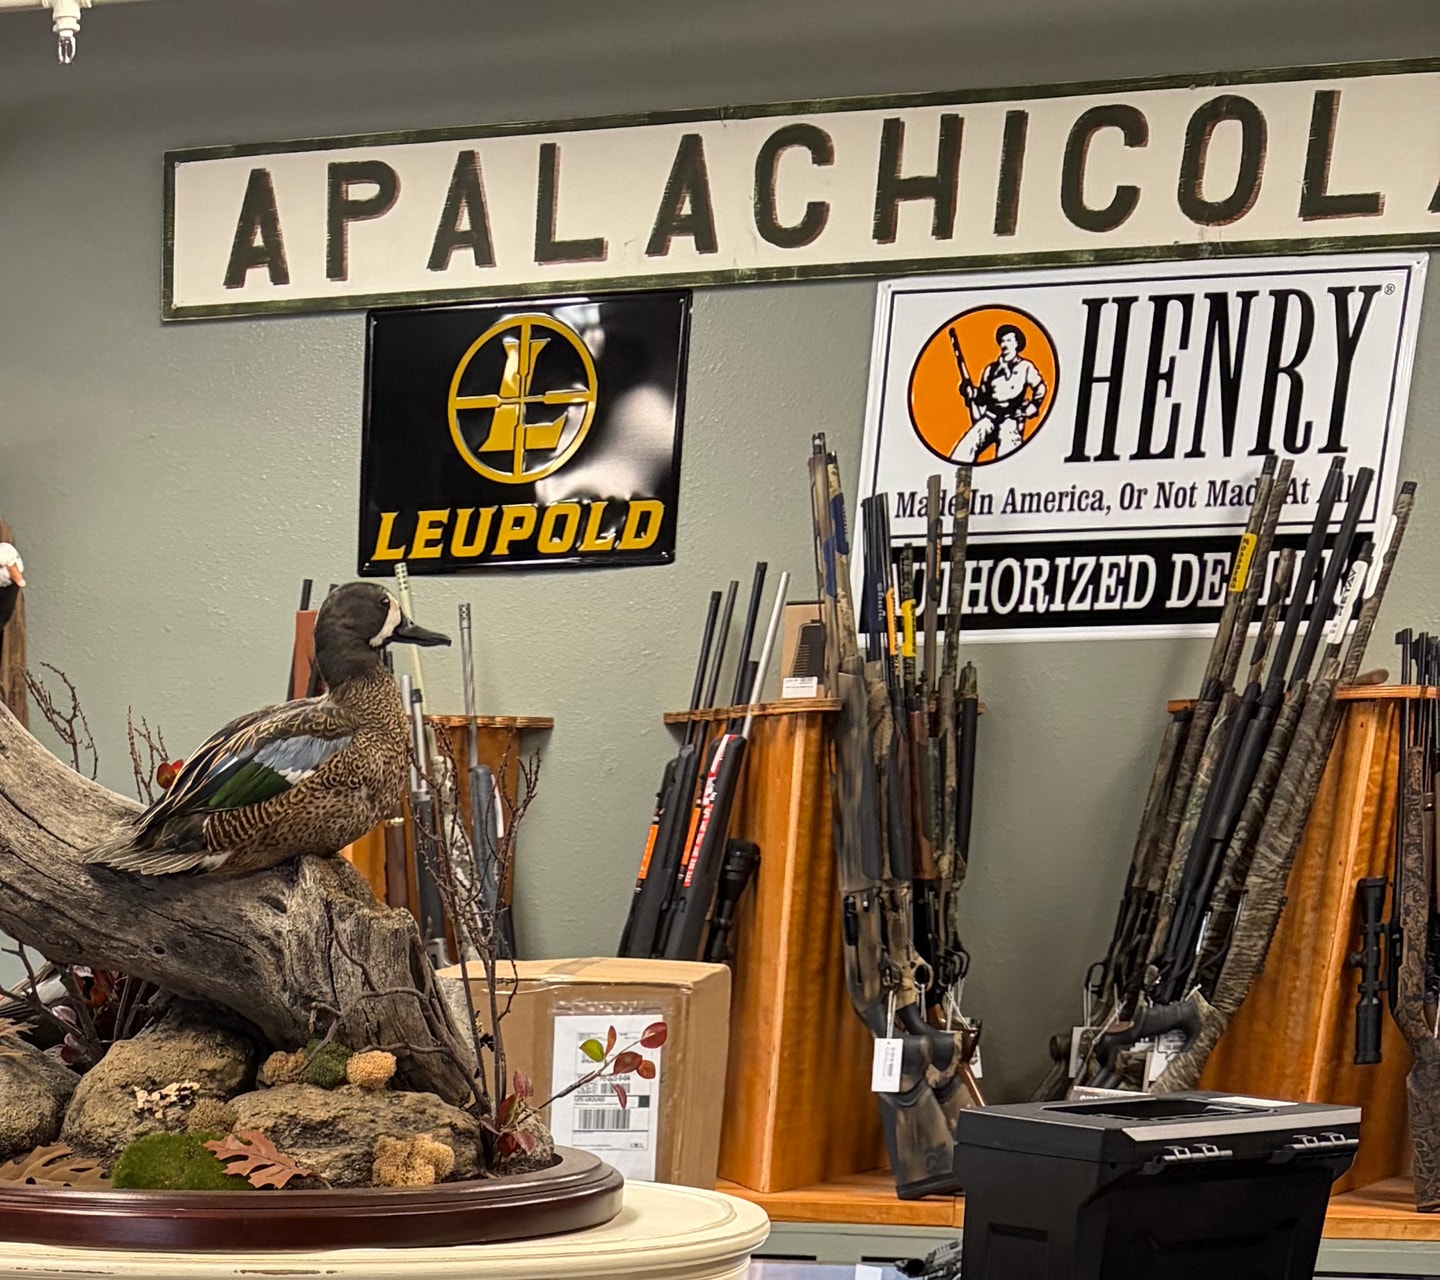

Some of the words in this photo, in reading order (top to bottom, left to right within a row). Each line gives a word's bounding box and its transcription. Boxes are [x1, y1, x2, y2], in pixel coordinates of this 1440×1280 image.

[222, 90, 1440, 289] APALACHICOL
[1065, 285, 1382, 463] HENRY
[372, 502, 664, 560] LEUPOLD
[1000, 484, 1111, 516] America,
[1119, 482, 1148, 510] Or
[1154, 478, 1198, 510] Not
[1205, 478, 1260, 508] Mad
